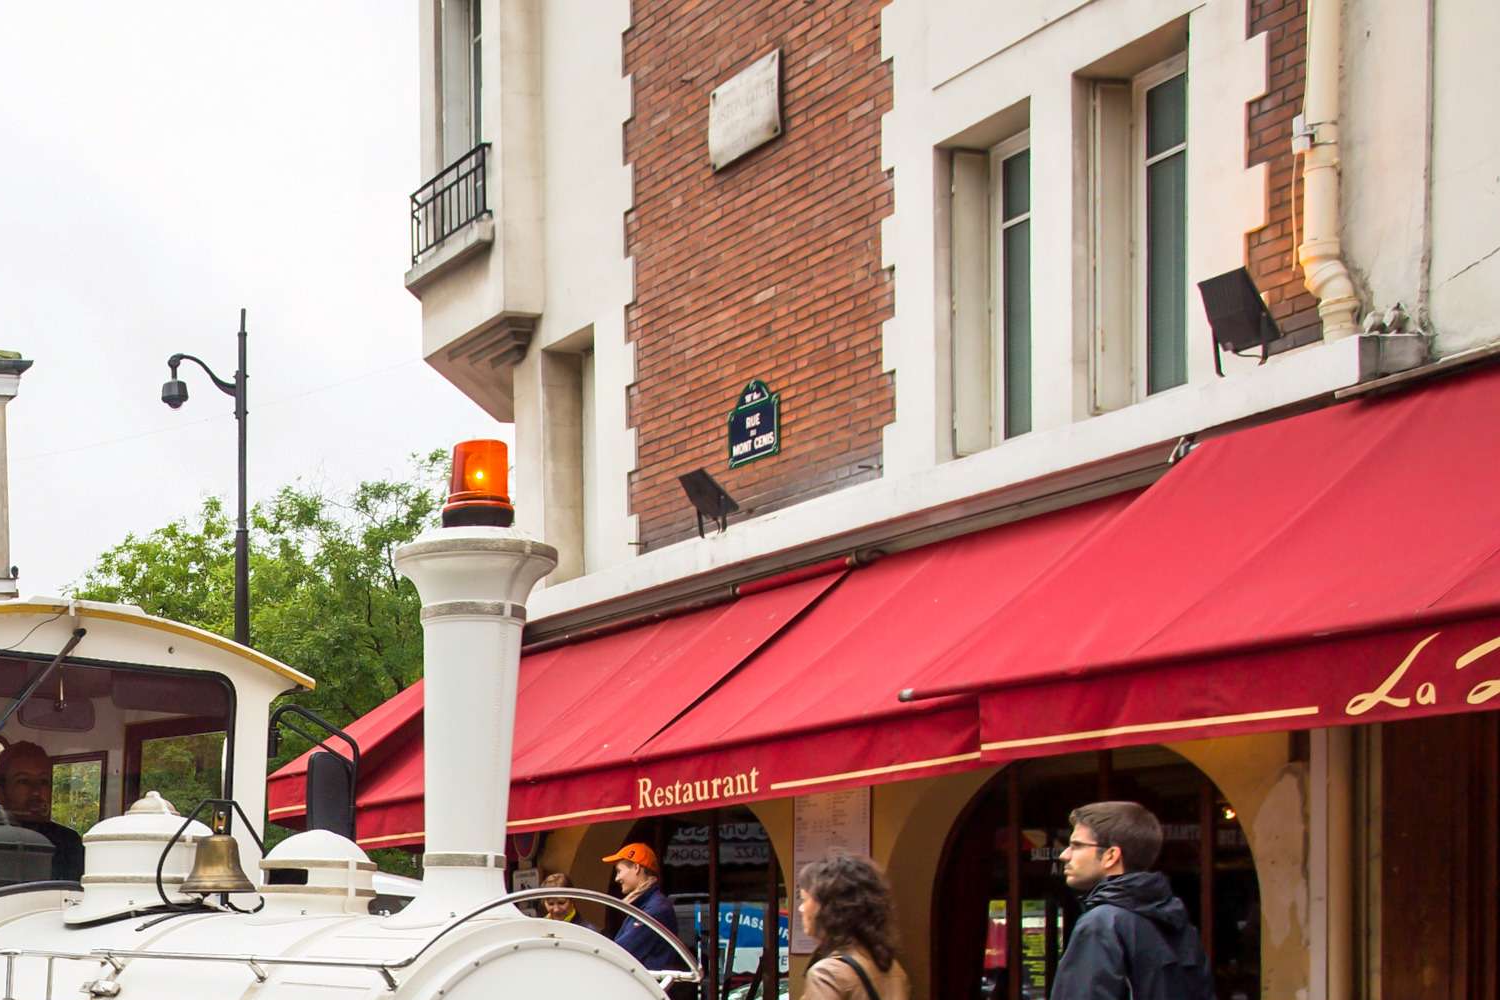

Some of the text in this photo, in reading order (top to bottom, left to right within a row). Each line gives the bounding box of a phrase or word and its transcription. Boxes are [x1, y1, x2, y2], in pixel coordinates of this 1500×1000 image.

[746, 412, 760, 429] RUE
[732, 431, 774, 457] MONT CENIS
[1345, 631, 1441, 716] La
[638, 766, 760, 810] Restaurant
